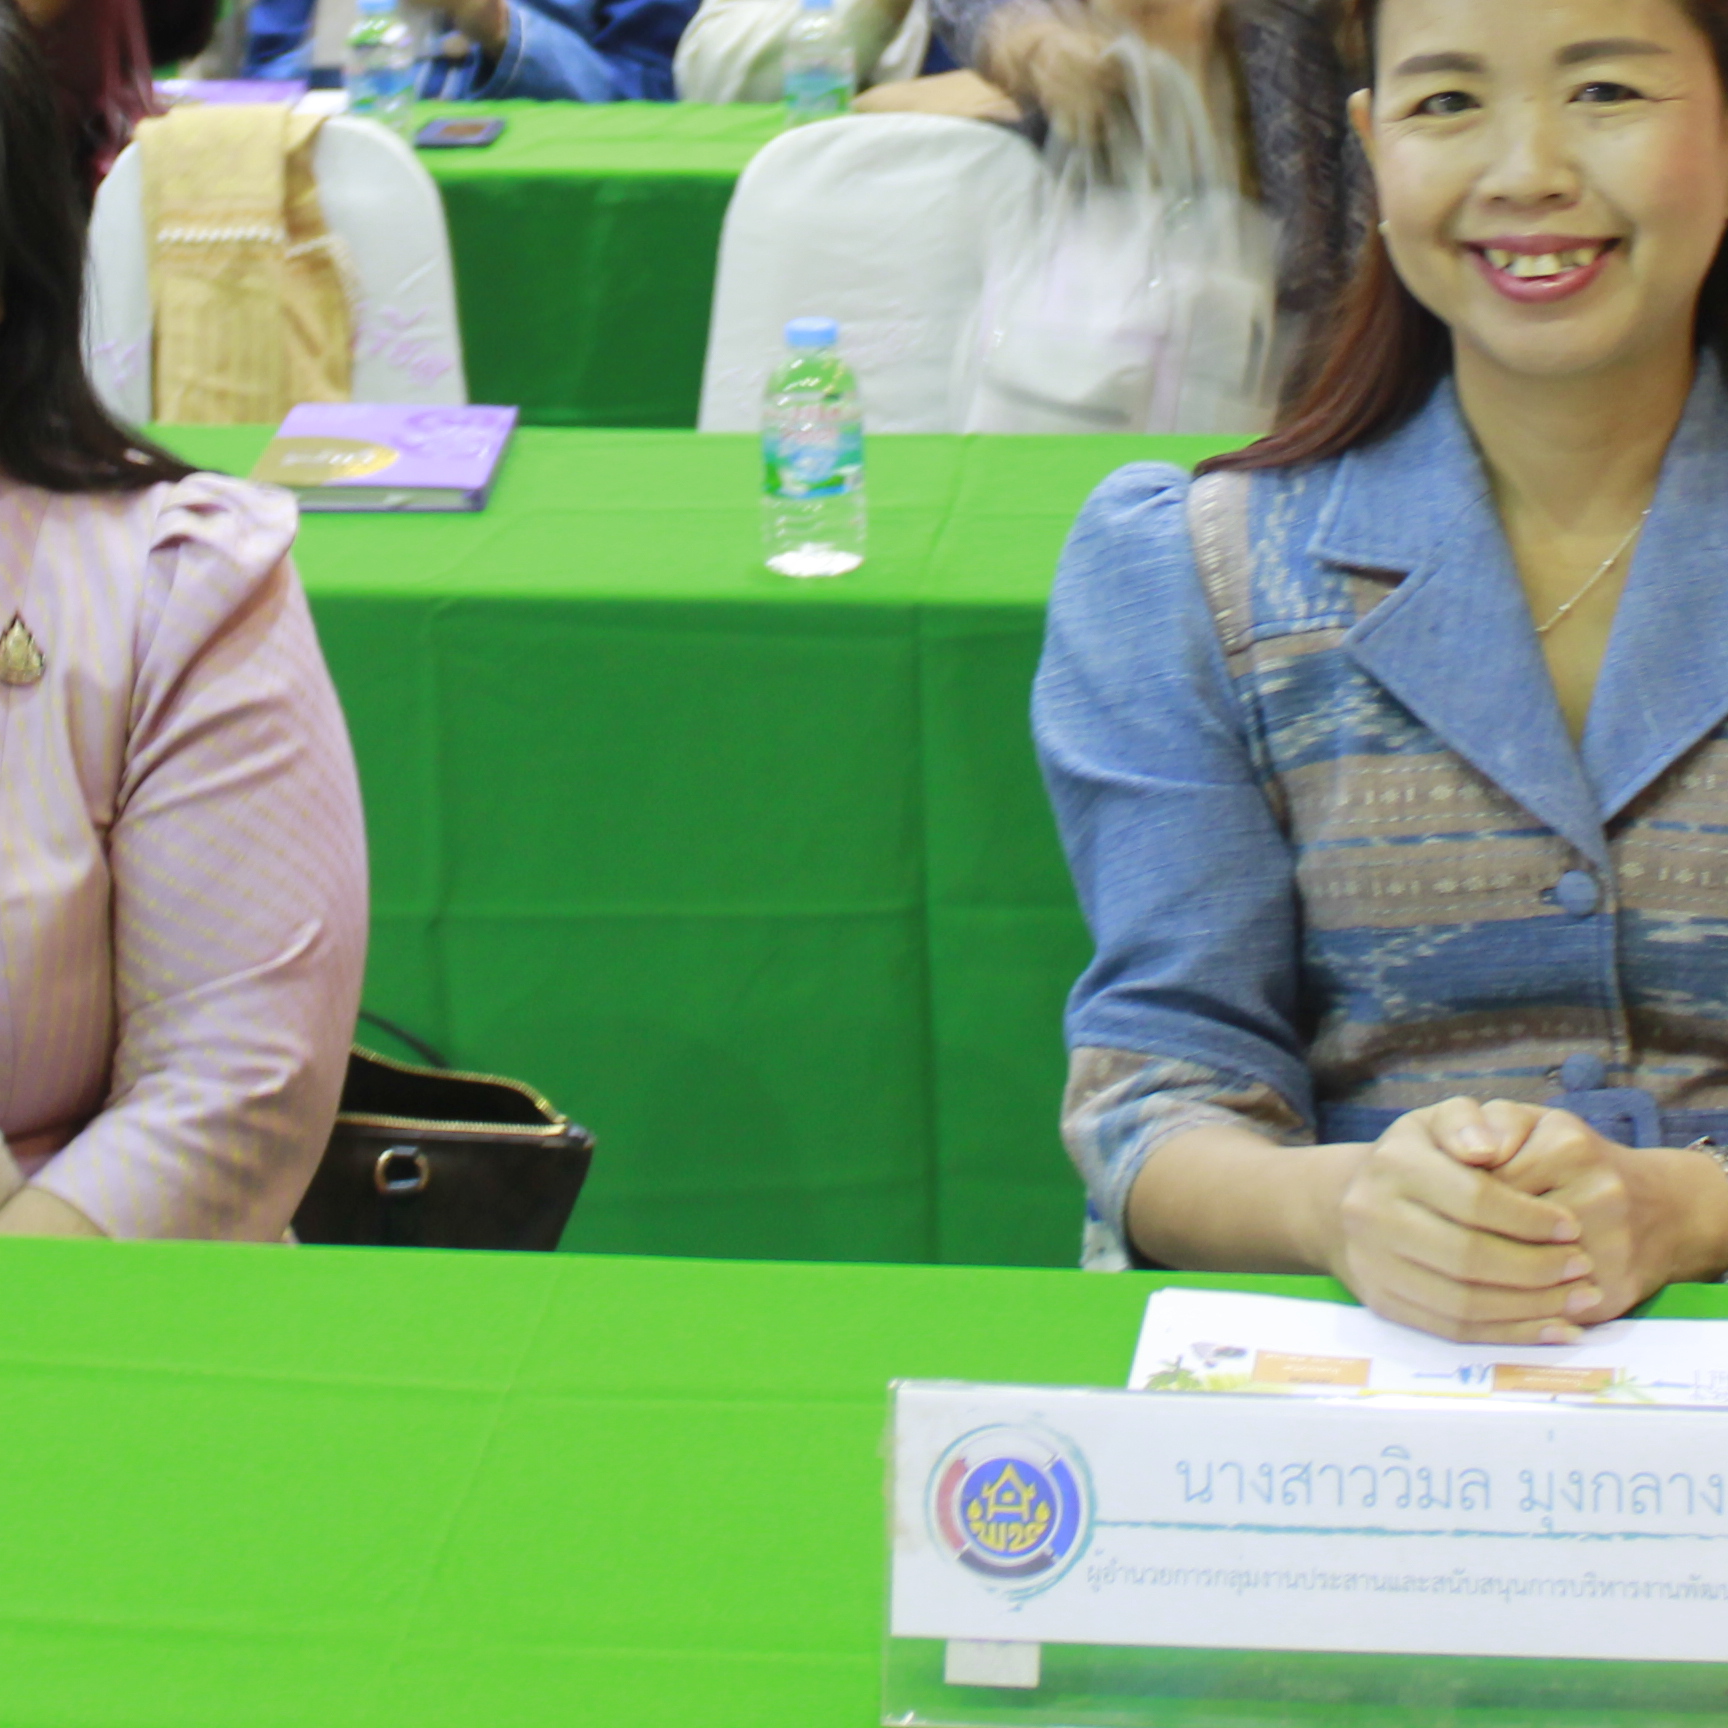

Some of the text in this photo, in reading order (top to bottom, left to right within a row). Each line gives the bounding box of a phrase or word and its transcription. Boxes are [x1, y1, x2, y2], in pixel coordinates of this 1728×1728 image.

[1174, 1428, 1727, 1534] นางสาววิมล มุ่งกลาง
